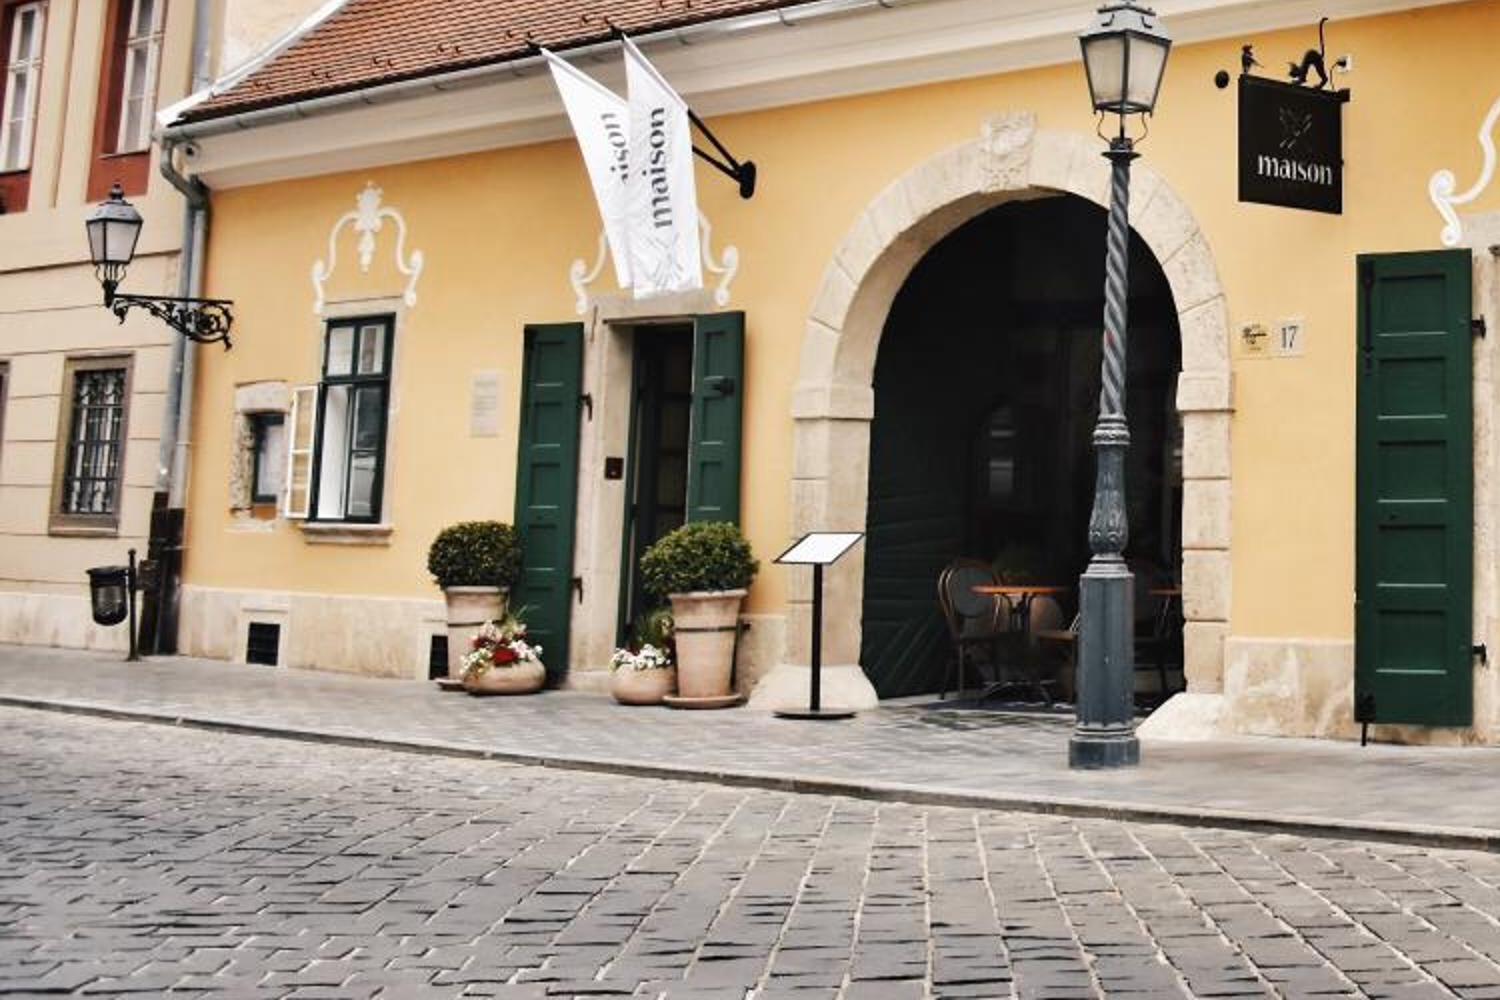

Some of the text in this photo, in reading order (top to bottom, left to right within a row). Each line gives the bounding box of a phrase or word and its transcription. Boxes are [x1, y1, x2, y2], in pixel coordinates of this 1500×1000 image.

[601, 113, 629, 184] ison
[642, 107, 673, 229] maison
[1257, 154, 1333, 185] maison
[1281, 325, 1298, 348] 17
